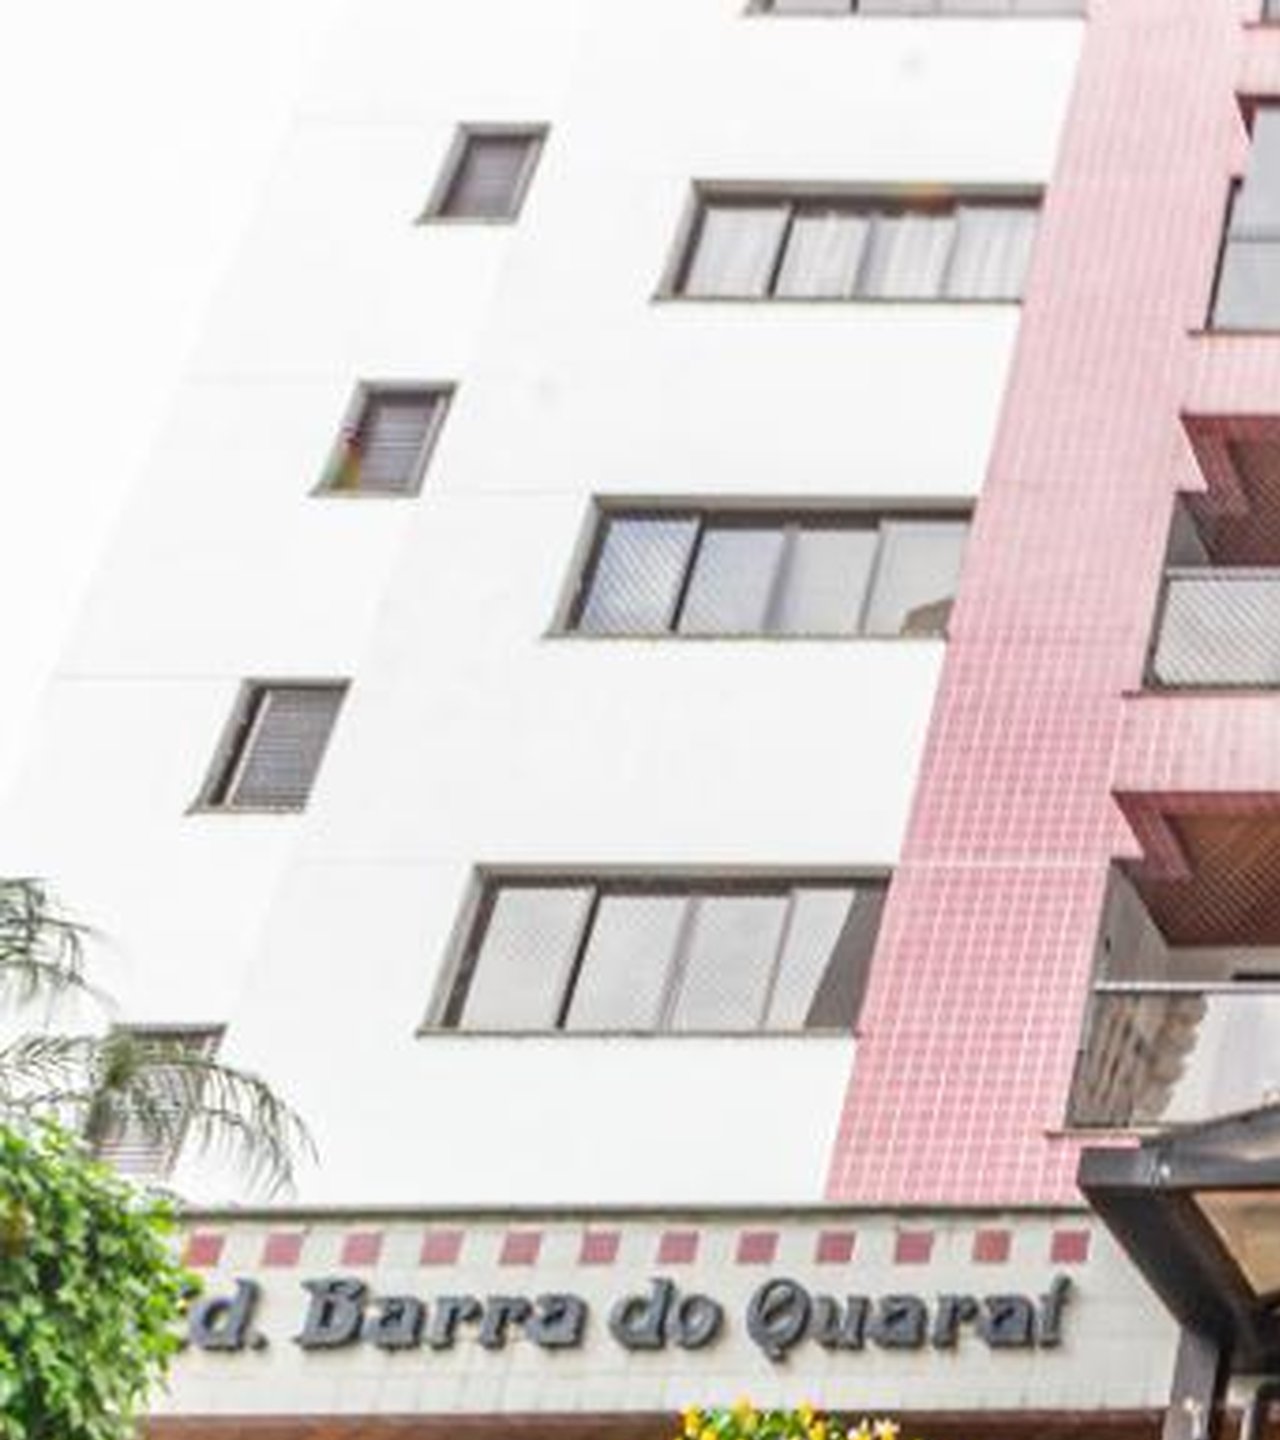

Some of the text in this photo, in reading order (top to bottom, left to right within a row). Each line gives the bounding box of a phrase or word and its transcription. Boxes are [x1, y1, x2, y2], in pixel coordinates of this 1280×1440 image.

[184, 1278, 269, 1352] d.
[295, 1277, 589, 1353] Barra
[609, 1277, 724, 1353] do
